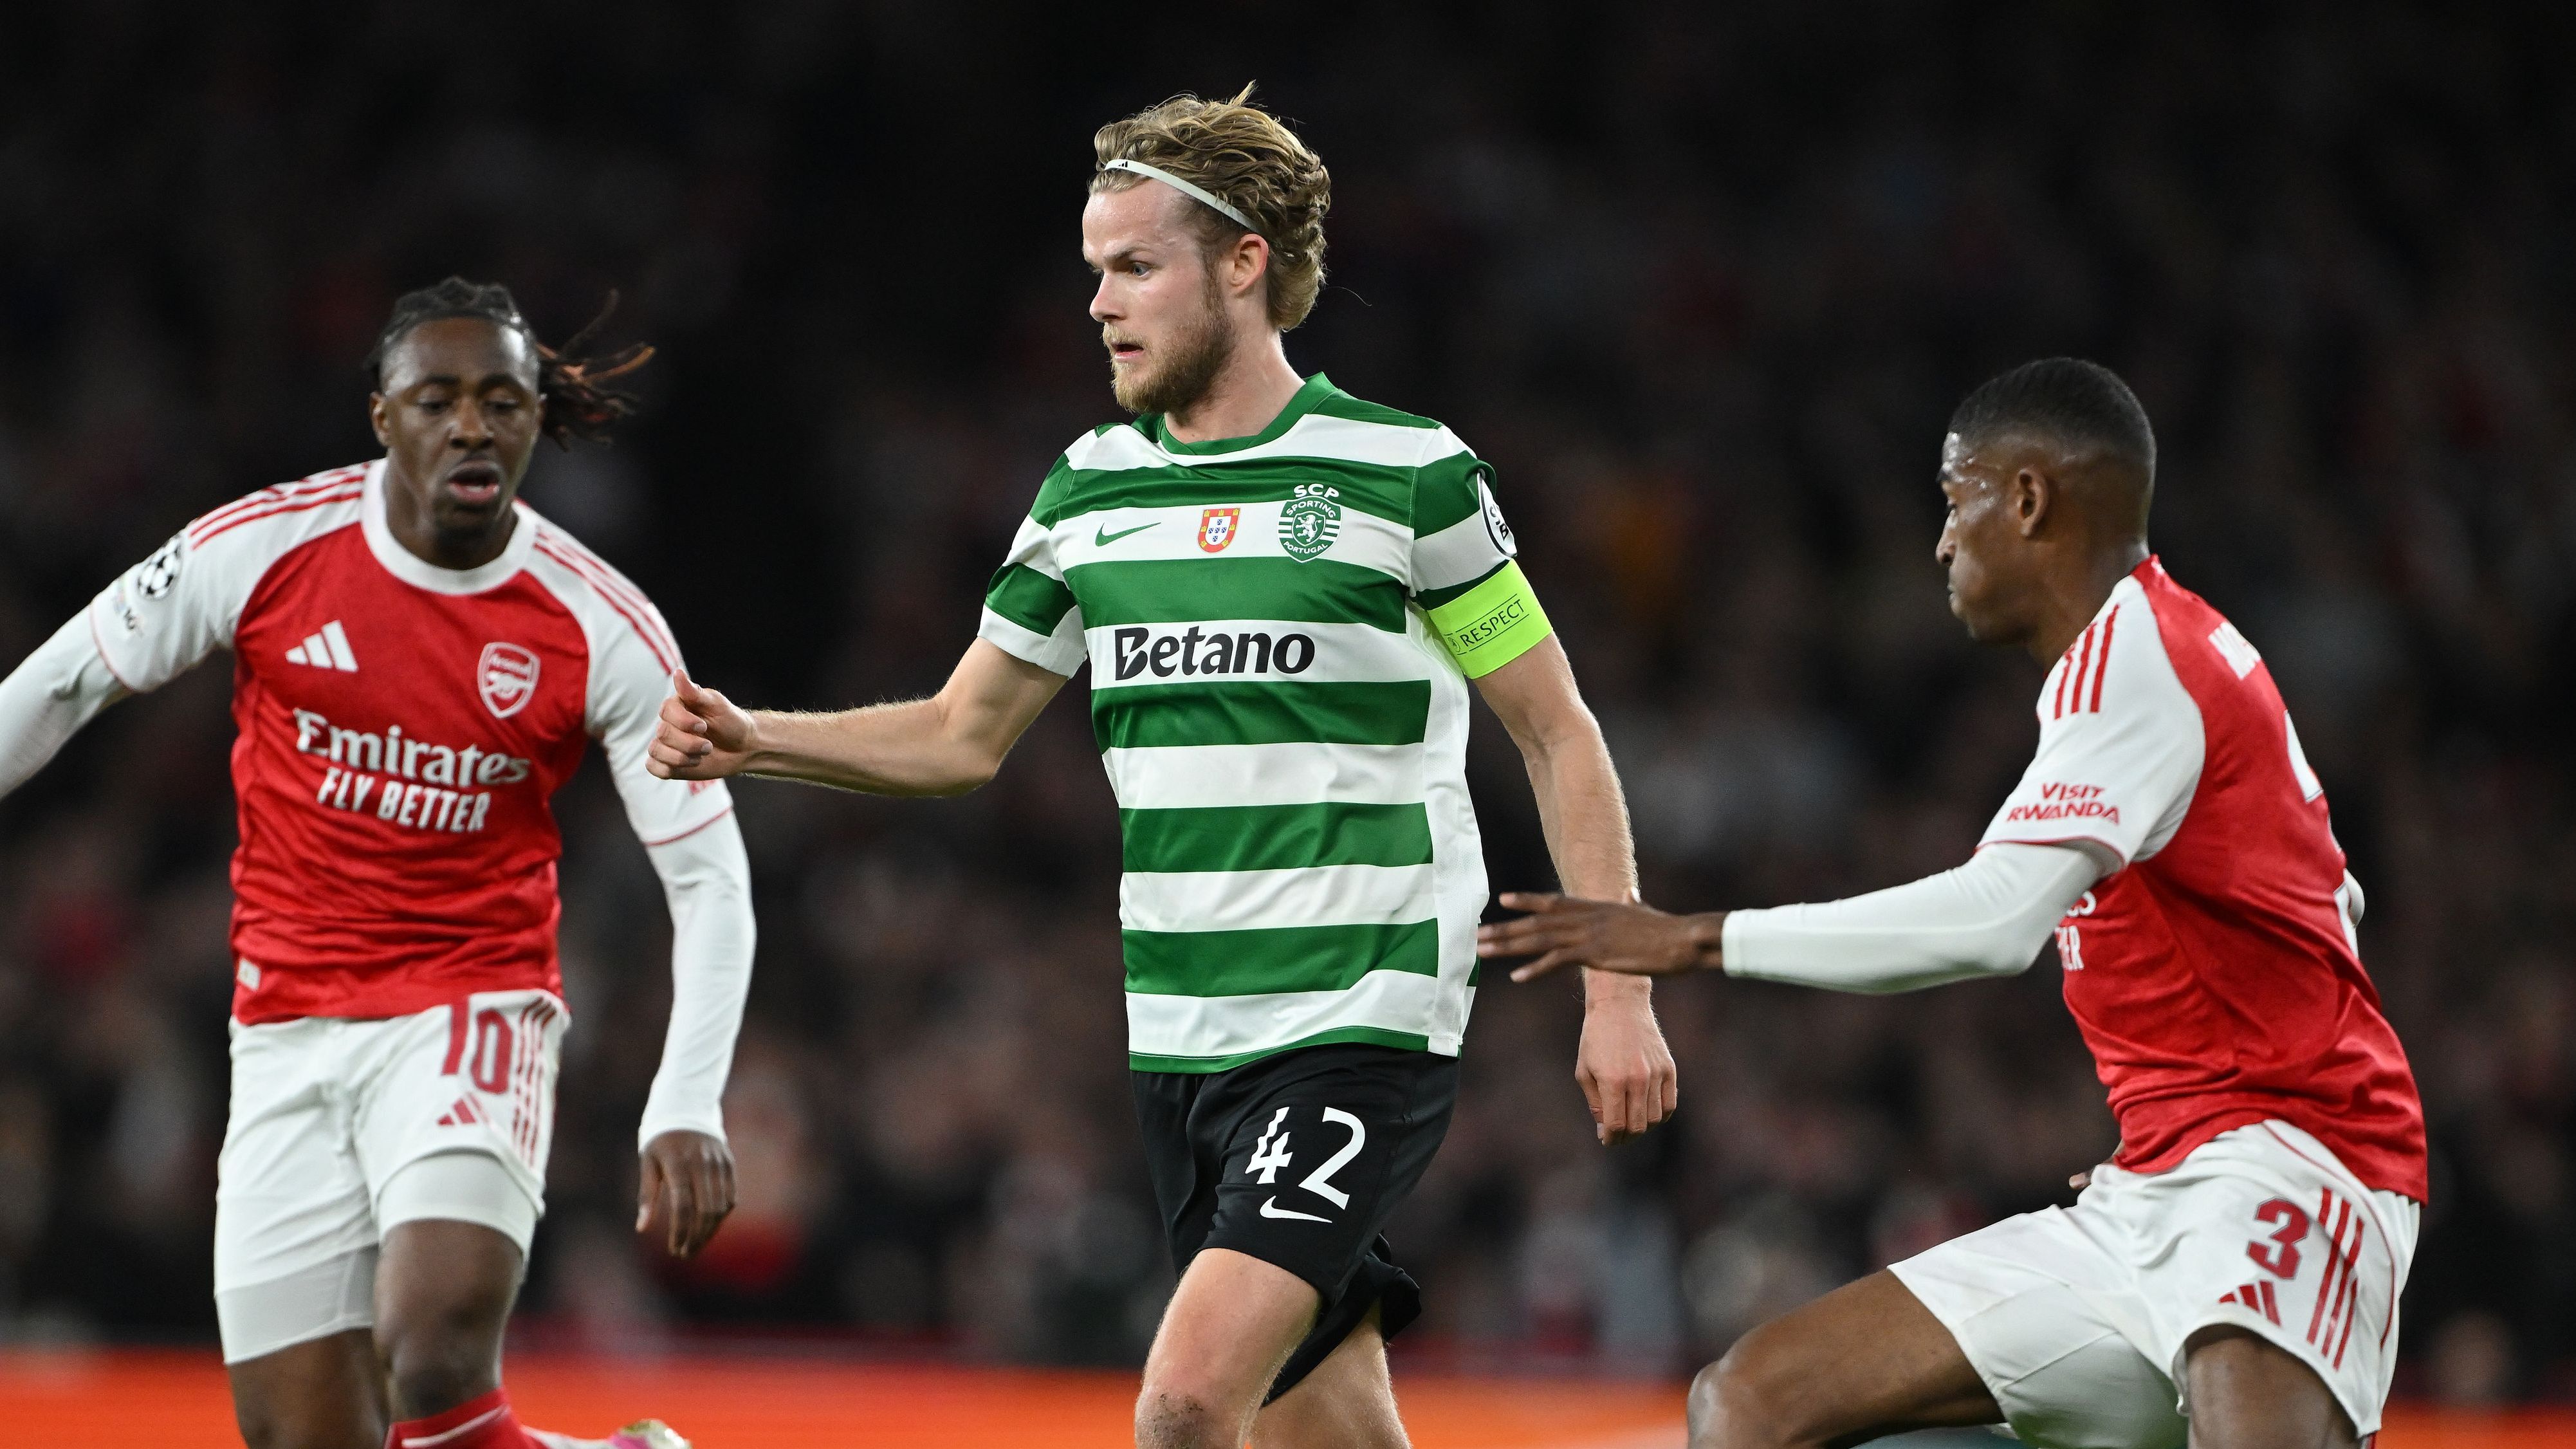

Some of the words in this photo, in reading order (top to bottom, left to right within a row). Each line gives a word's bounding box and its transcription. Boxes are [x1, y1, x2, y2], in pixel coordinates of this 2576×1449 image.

[1286, 500, 1336, 518] SPORTING
[1293, 483, 1339, 498] SCP
[1283, 541, 1329, 554] PORTUGAL
[1459, 598, 1525, 647] RESPECT
[1114, 625, 1315, 681] Betano
[293, 708, 531, 789] Emirates
[316, 766, 375, 811] FLY
[376, 791, 491, 833] BETTER
[2006, 802, 2121, 826] RWANDA
[2042, 782, 2105, 801] VISIT
[441, 993, 513, 1094] 10
[1245, 1106, 1366, 1210] 42
[2246, 1195, 2310, 1280] 3
